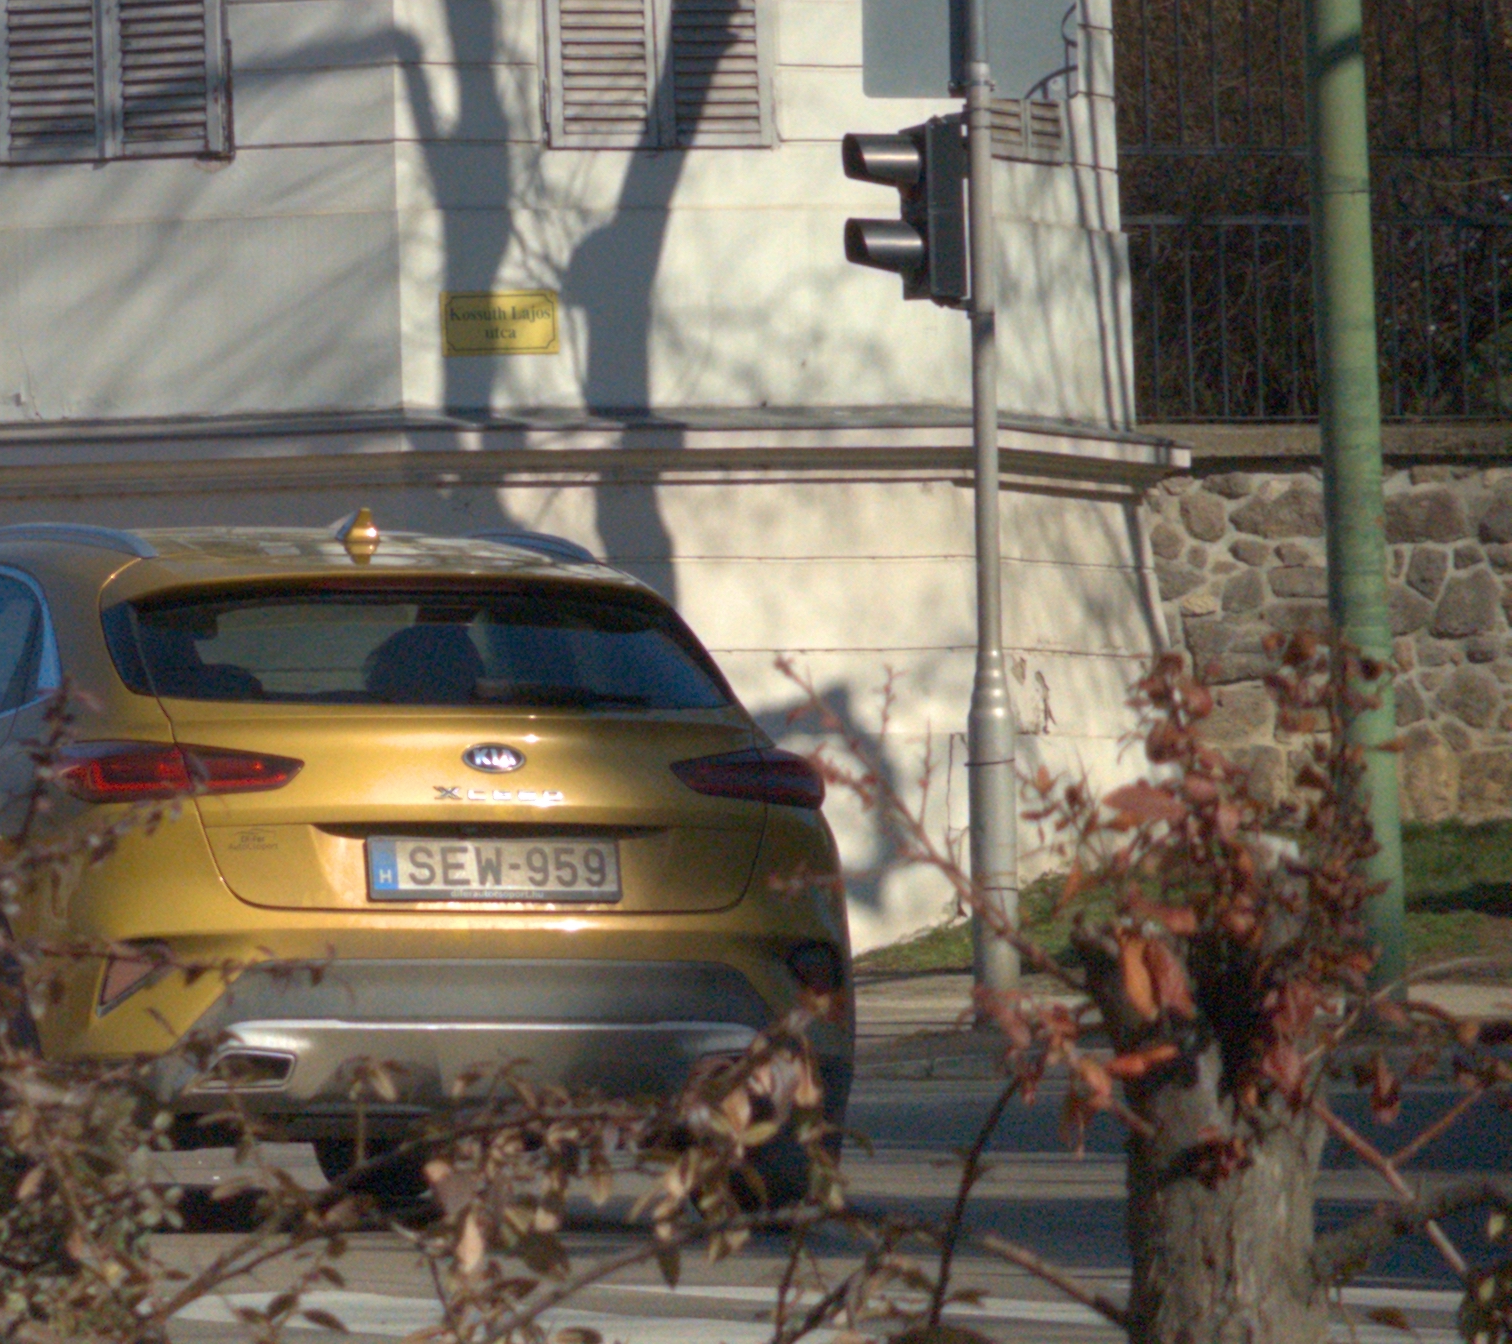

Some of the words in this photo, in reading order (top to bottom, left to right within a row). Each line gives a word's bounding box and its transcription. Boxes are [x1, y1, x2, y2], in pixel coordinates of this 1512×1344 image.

[450, 307, 506, 321] Kossuth
[511, 305, 551, 323] Lajos
[485, 327, 516, 339] utca
[379, 869, 392, 883] H
[408, 845, 607, 887] SEW-959
